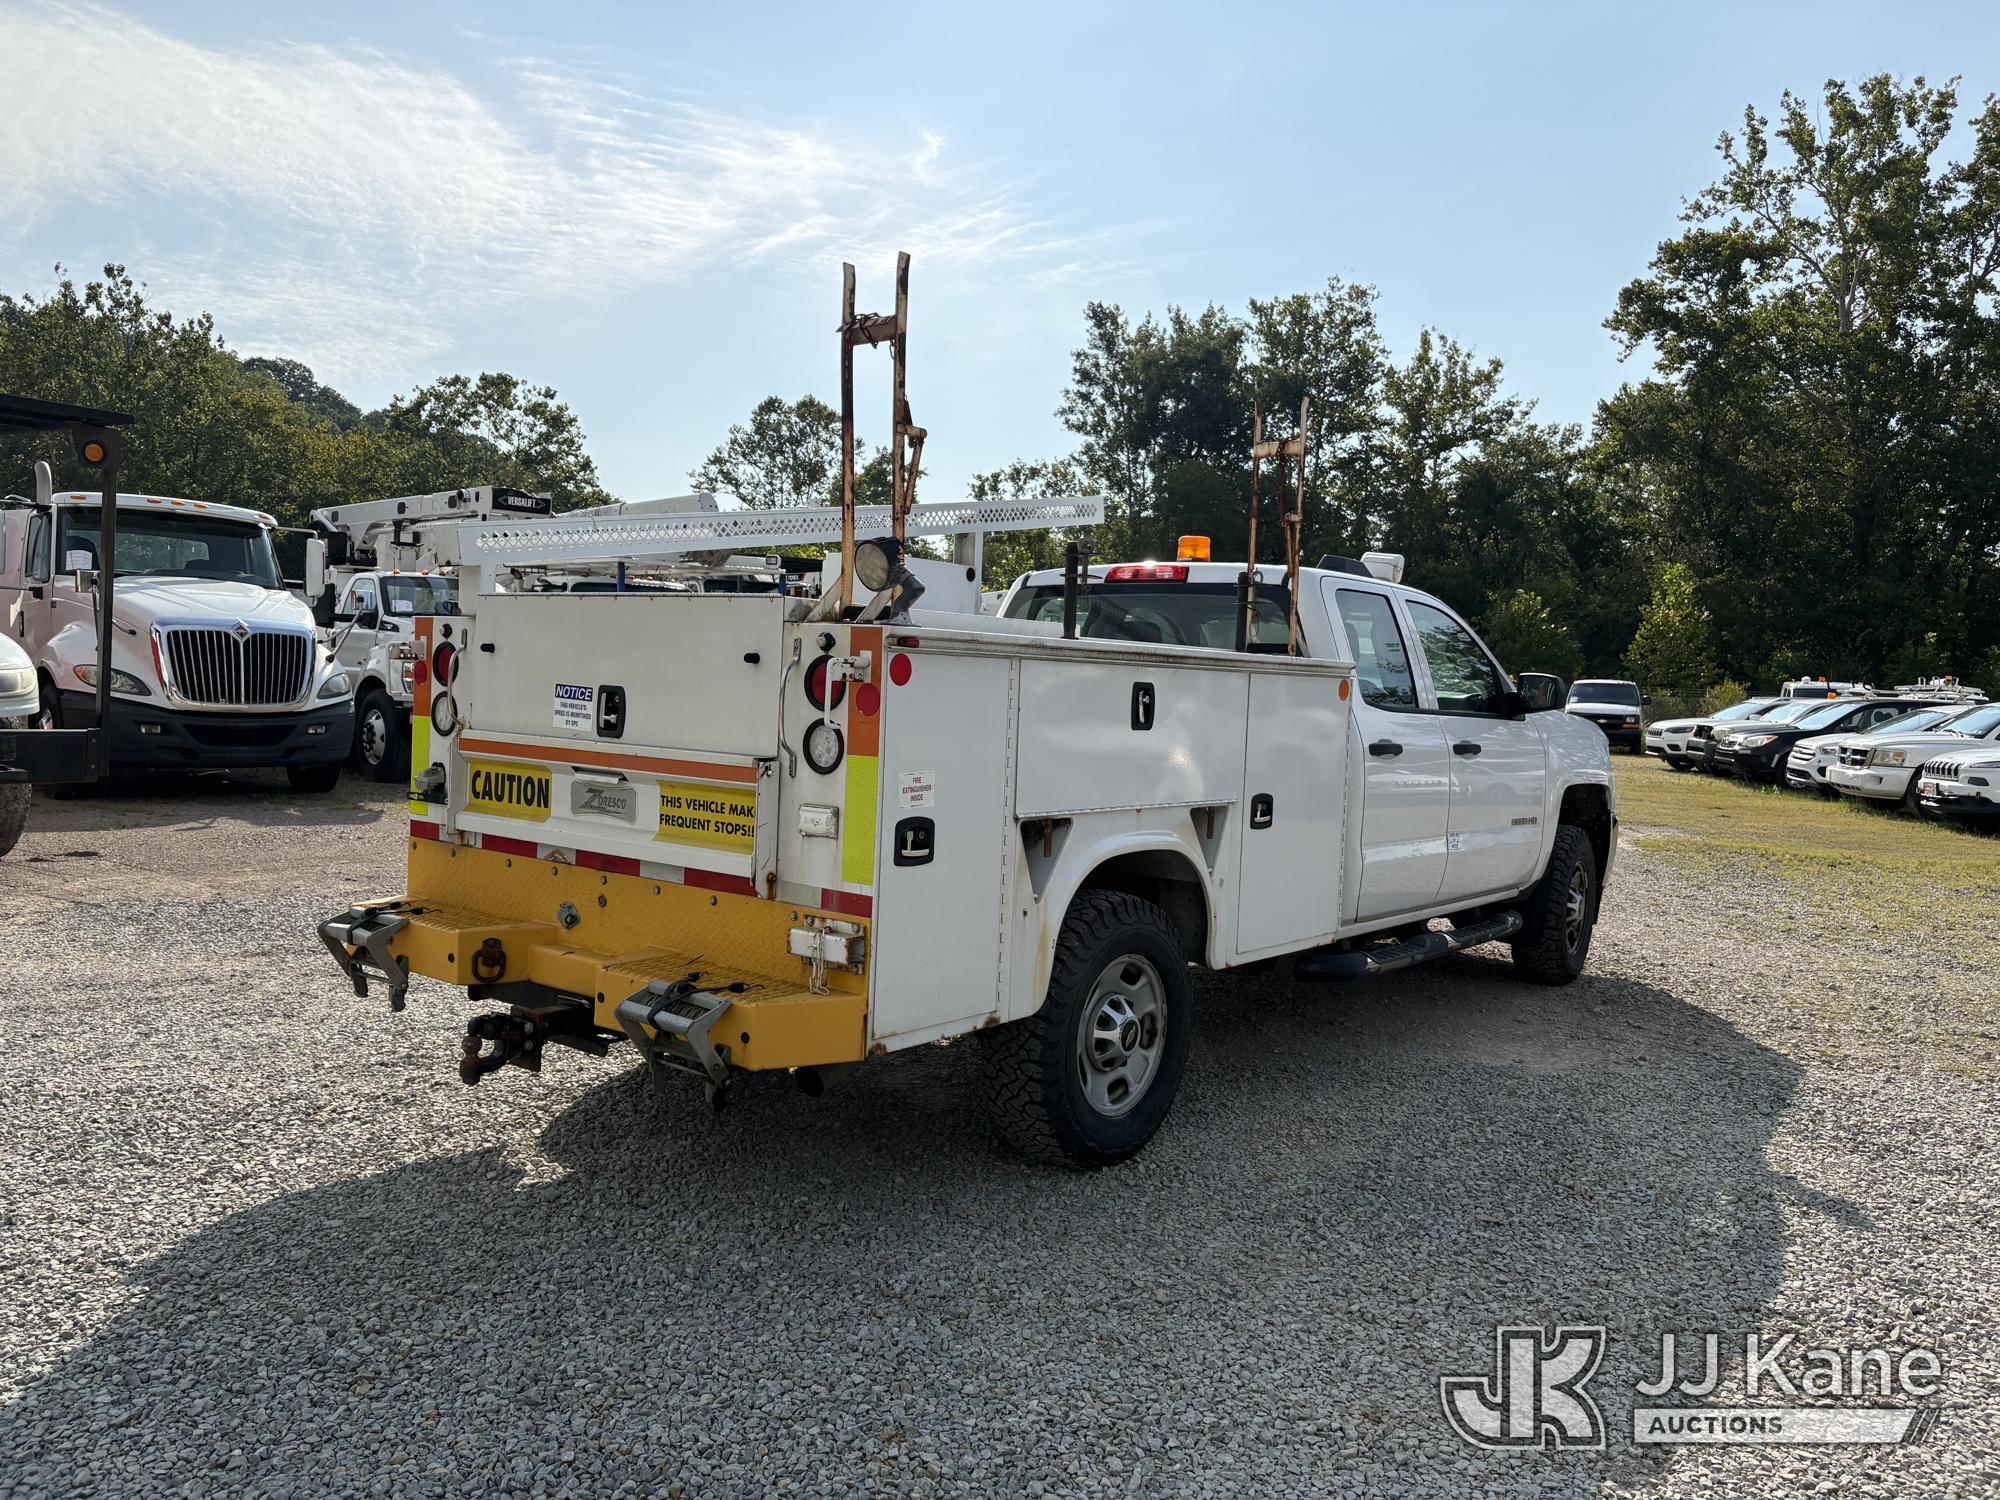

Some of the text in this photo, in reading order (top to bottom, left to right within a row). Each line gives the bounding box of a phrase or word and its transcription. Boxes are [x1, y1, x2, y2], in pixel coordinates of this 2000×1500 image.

[507, 495, 536, 508] VERSALIFT
[555, 685, 592, 700] NOTICE
[471, 770, 549, 808] CAUTION
[579, 788, 627, 810] ZORESCO
[660, 795, 755, 818] THIS VEHICLE MAK
[659, 813, 711, 832] FREQUENT
